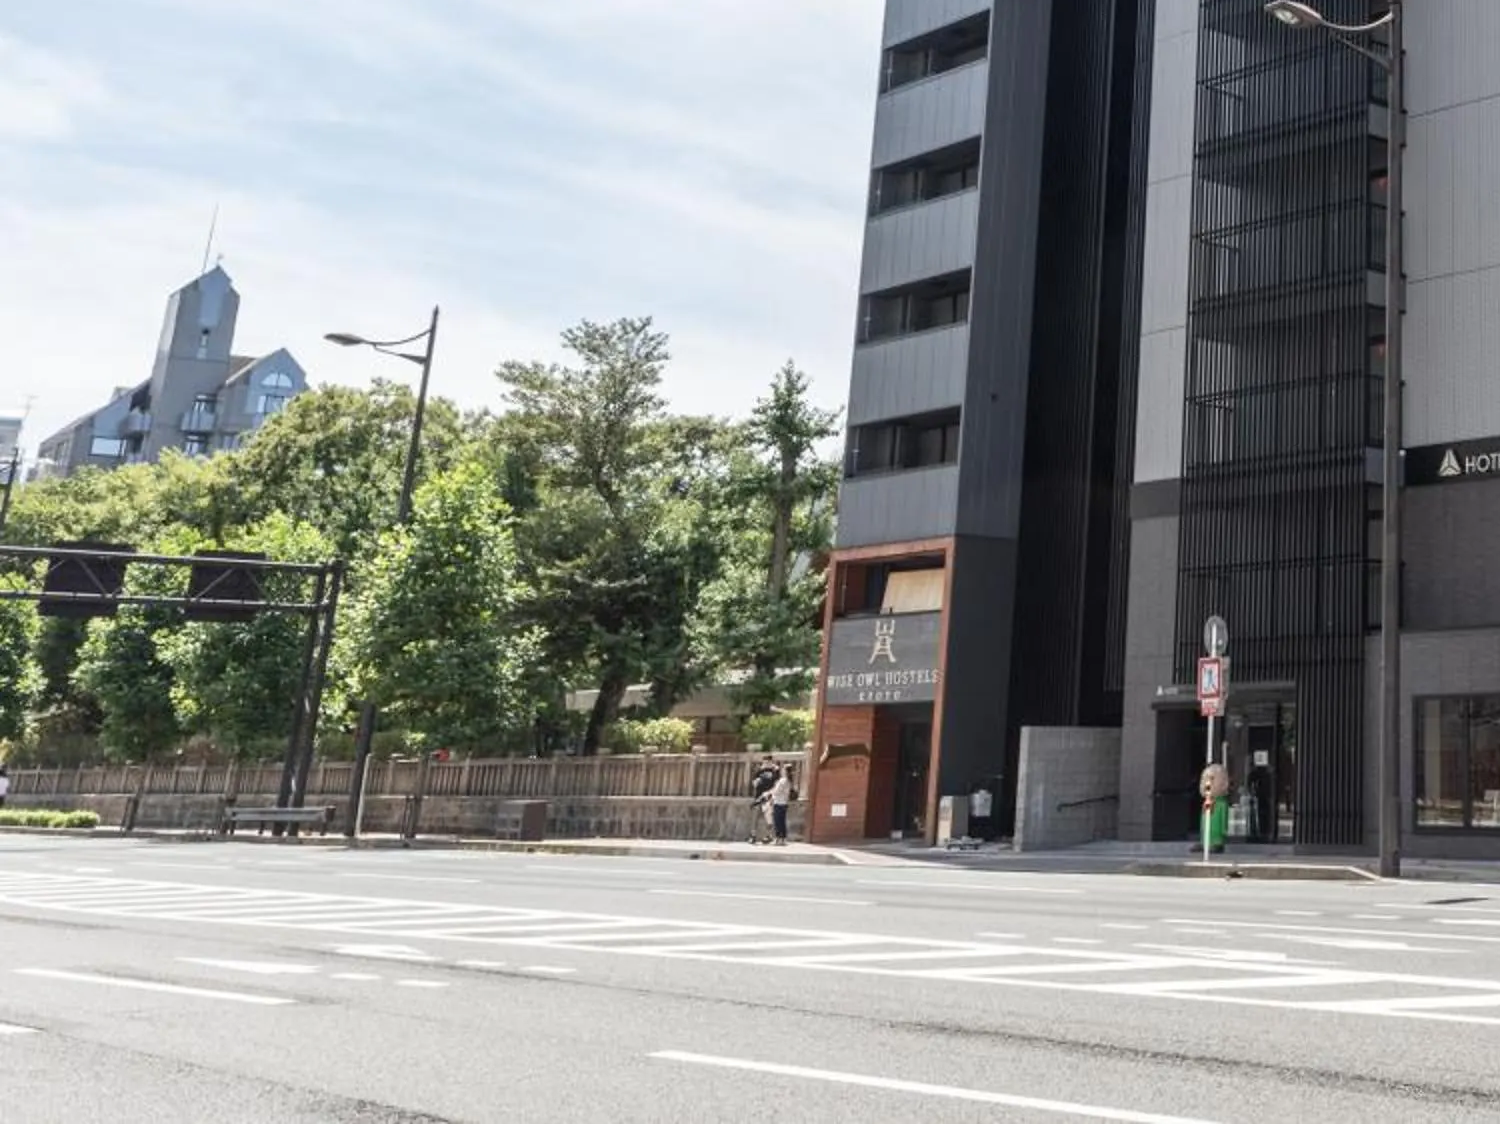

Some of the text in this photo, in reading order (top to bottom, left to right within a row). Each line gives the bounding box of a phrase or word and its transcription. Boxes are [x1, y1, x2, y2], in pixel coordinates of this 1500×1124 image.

[827, 668, 942, 688] WISE OWL HOSTELS
